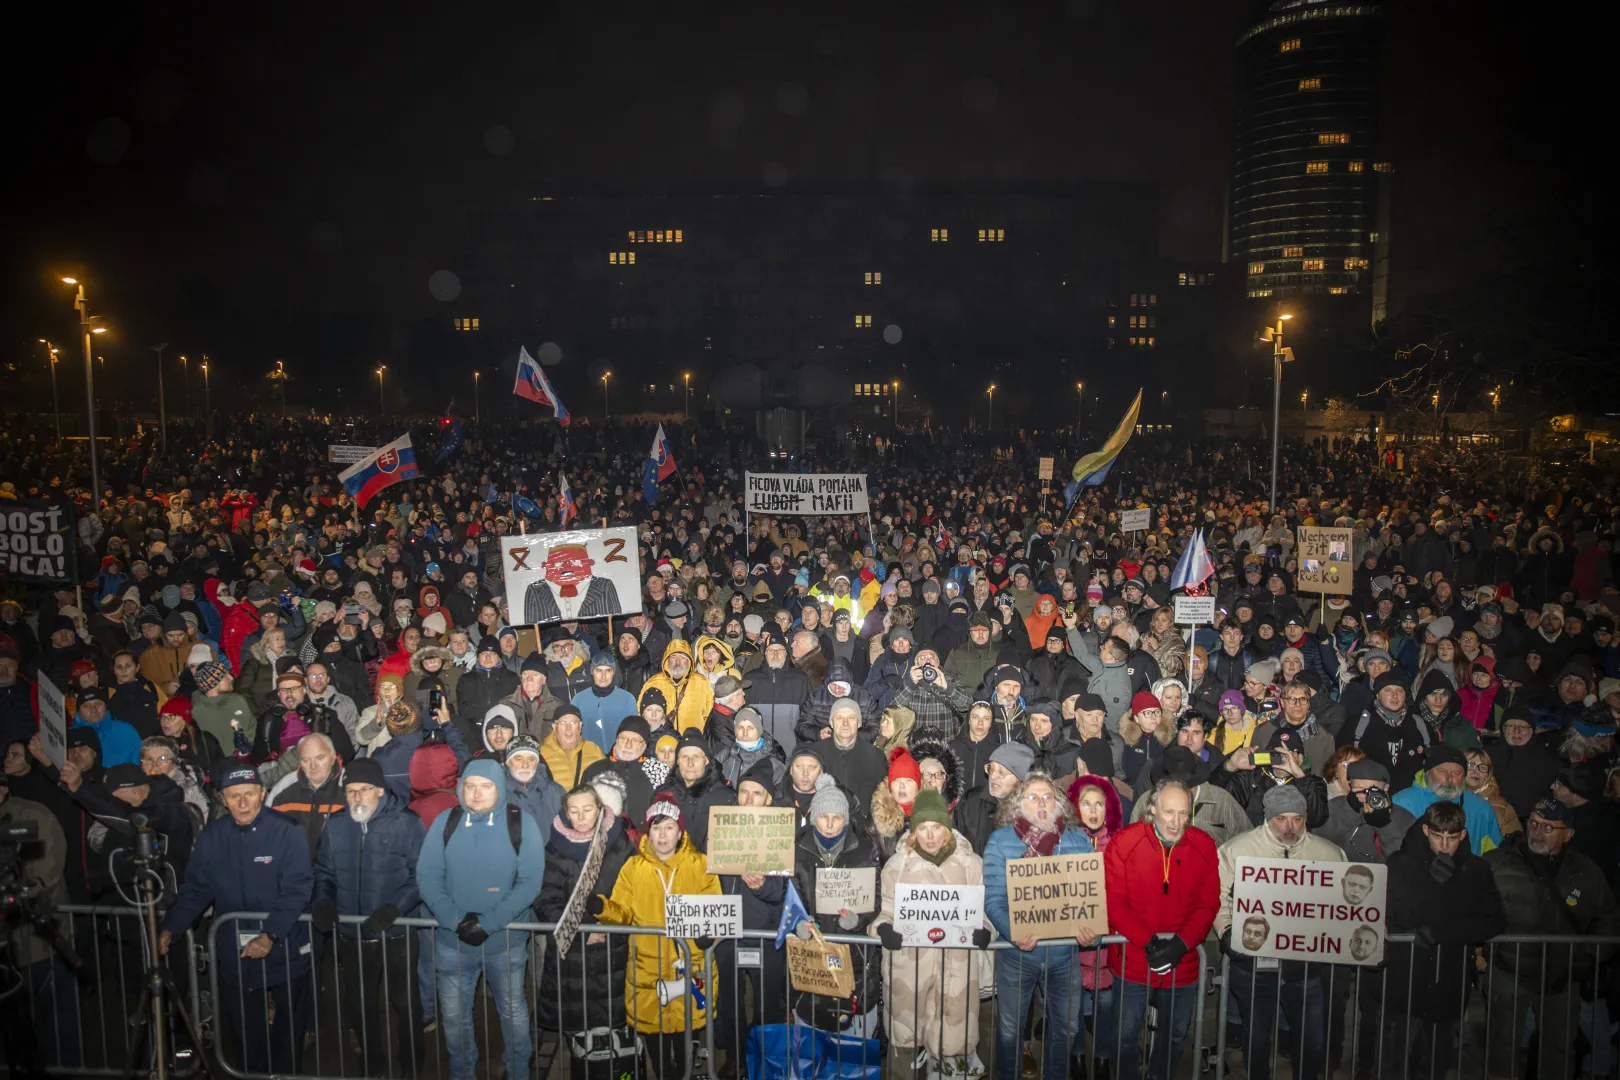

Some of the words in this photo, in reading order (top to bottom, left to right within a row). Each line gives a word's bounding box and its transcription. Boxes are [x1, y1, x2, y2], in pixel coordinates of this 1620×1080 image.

[749, 477, 781, 492] FICOVA
[783, 476, 814, 493] VLÁDA
[819, 475, 863, 493] POMÁHA
[713, 813, 755, 826] TREBA
[749, 840, 758, 851] A
[767, 839, 793, 851] SNS
[1009, 862, 1062, 878] PODLIAK
[1066, 859, 1099, 873] FICO
[1241, 865, 1335, 888] PATRÍTE
[666, 894, 684, 904] KDE
[1013, 881, 1099, 902] DEMONTUJE
[666, 902, 701, 917] VLÁDA
[703, 904, 737, 917] KRYJE
[899, 905, 960, 921] ŠPINAVÁ
[1013, 905, 1057, 925] PRÁVNY
[1060, 901, 1100, 920] ŠTÁT
[1236, 898, 1266, 915] NA
[1271, 900, 1381, 923] SMETISKO
[667, 917, 684, 925] TAM
[668, 924, 701, 937] MAFIA
[703, 920, 737, 937] ŽIJE
[1275, 932, 1342, 954] DEJÍN
[791, 956, 808, 966] FICO
